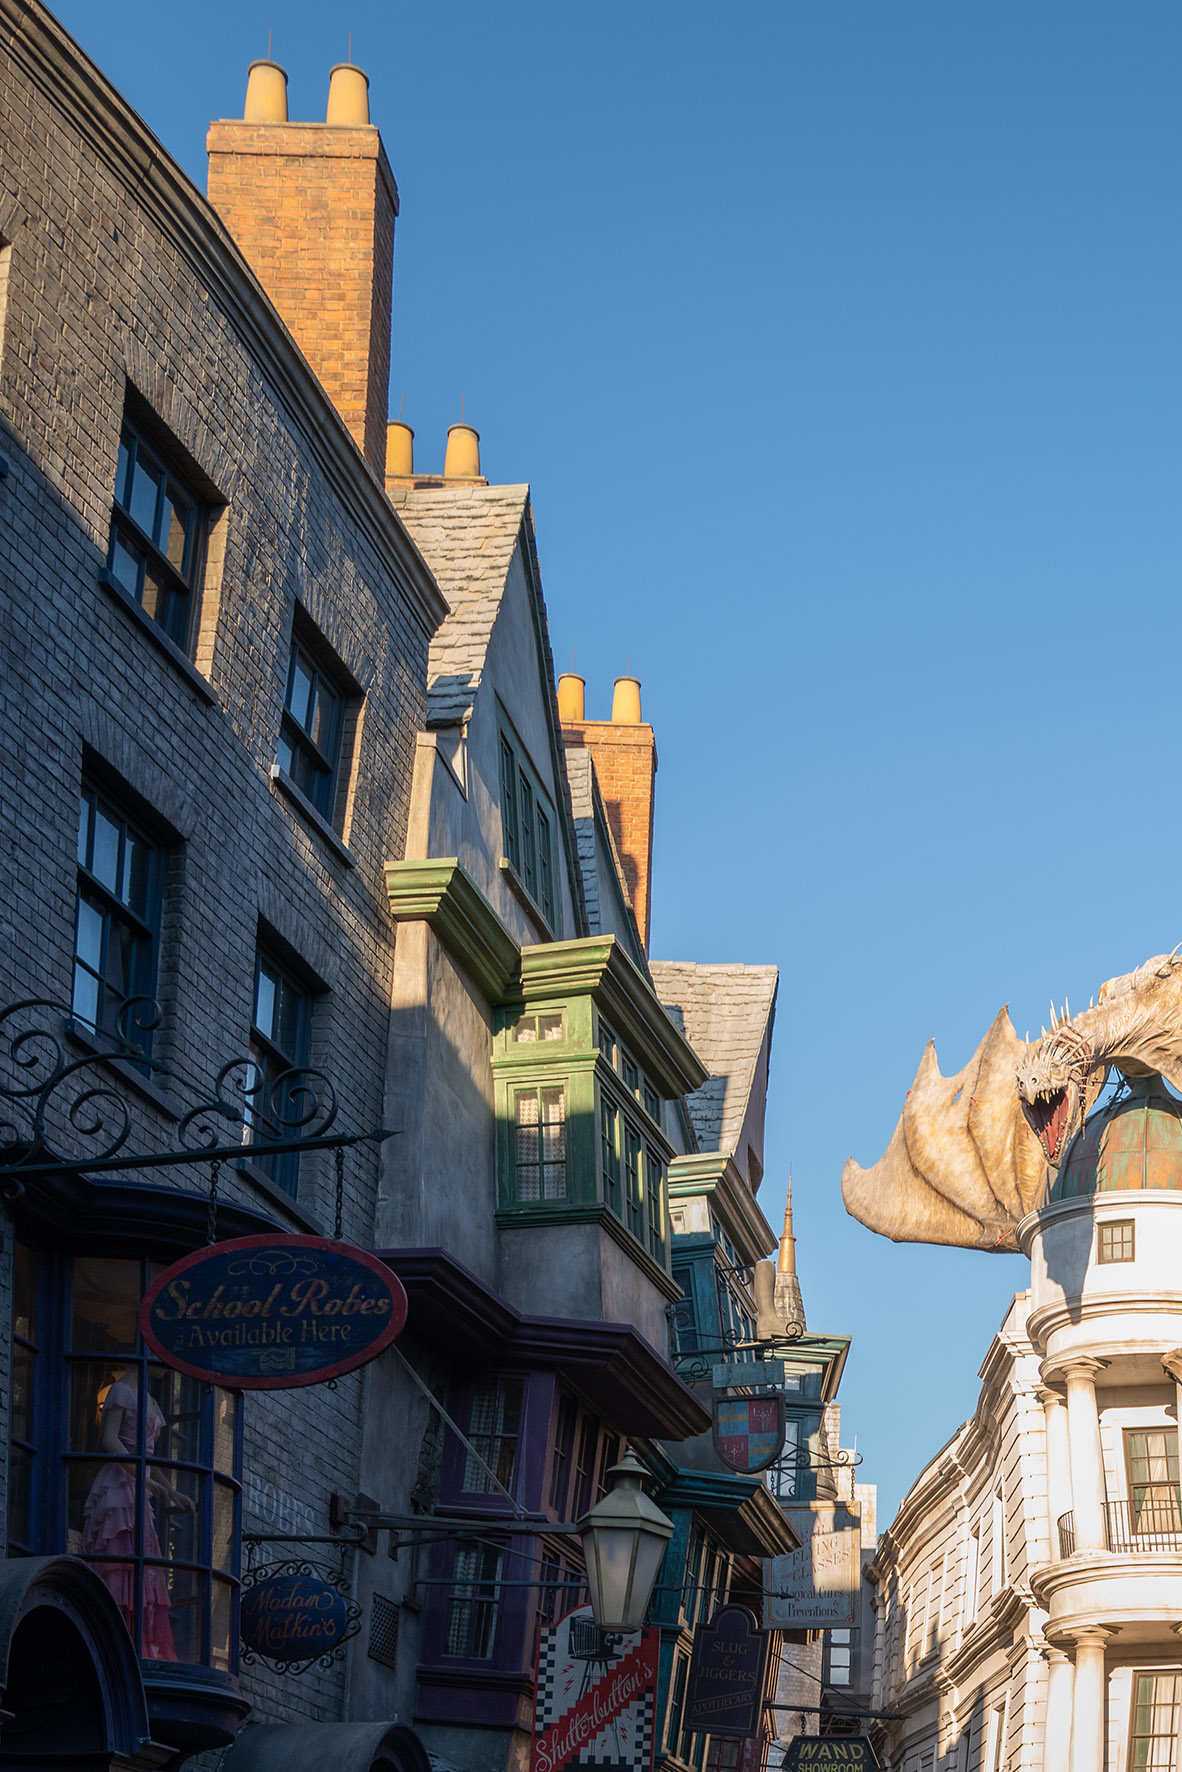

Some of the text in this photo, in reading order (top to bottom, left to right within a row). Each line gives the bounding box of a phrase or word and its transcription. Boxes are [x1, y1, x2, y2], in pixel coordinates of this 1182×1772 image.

[155, 1278, 390, 1320] School Robes
[189, 1319, 351, 1347] Available Here
[247, 1582, 335, 1615] Madam
[788, 1603, 839, 1617] Preventions
[250, 1613, 336, 1650] Malkin's
[712, 1641, 748, 1654] SLUG
[722, 1656, 736, 1666] &
[698, 1666, 757, 1682] JIGGERS
[691, 1692, 753, 1714] APOTHECARY
[799, 1743, 865, 1760] WAND
